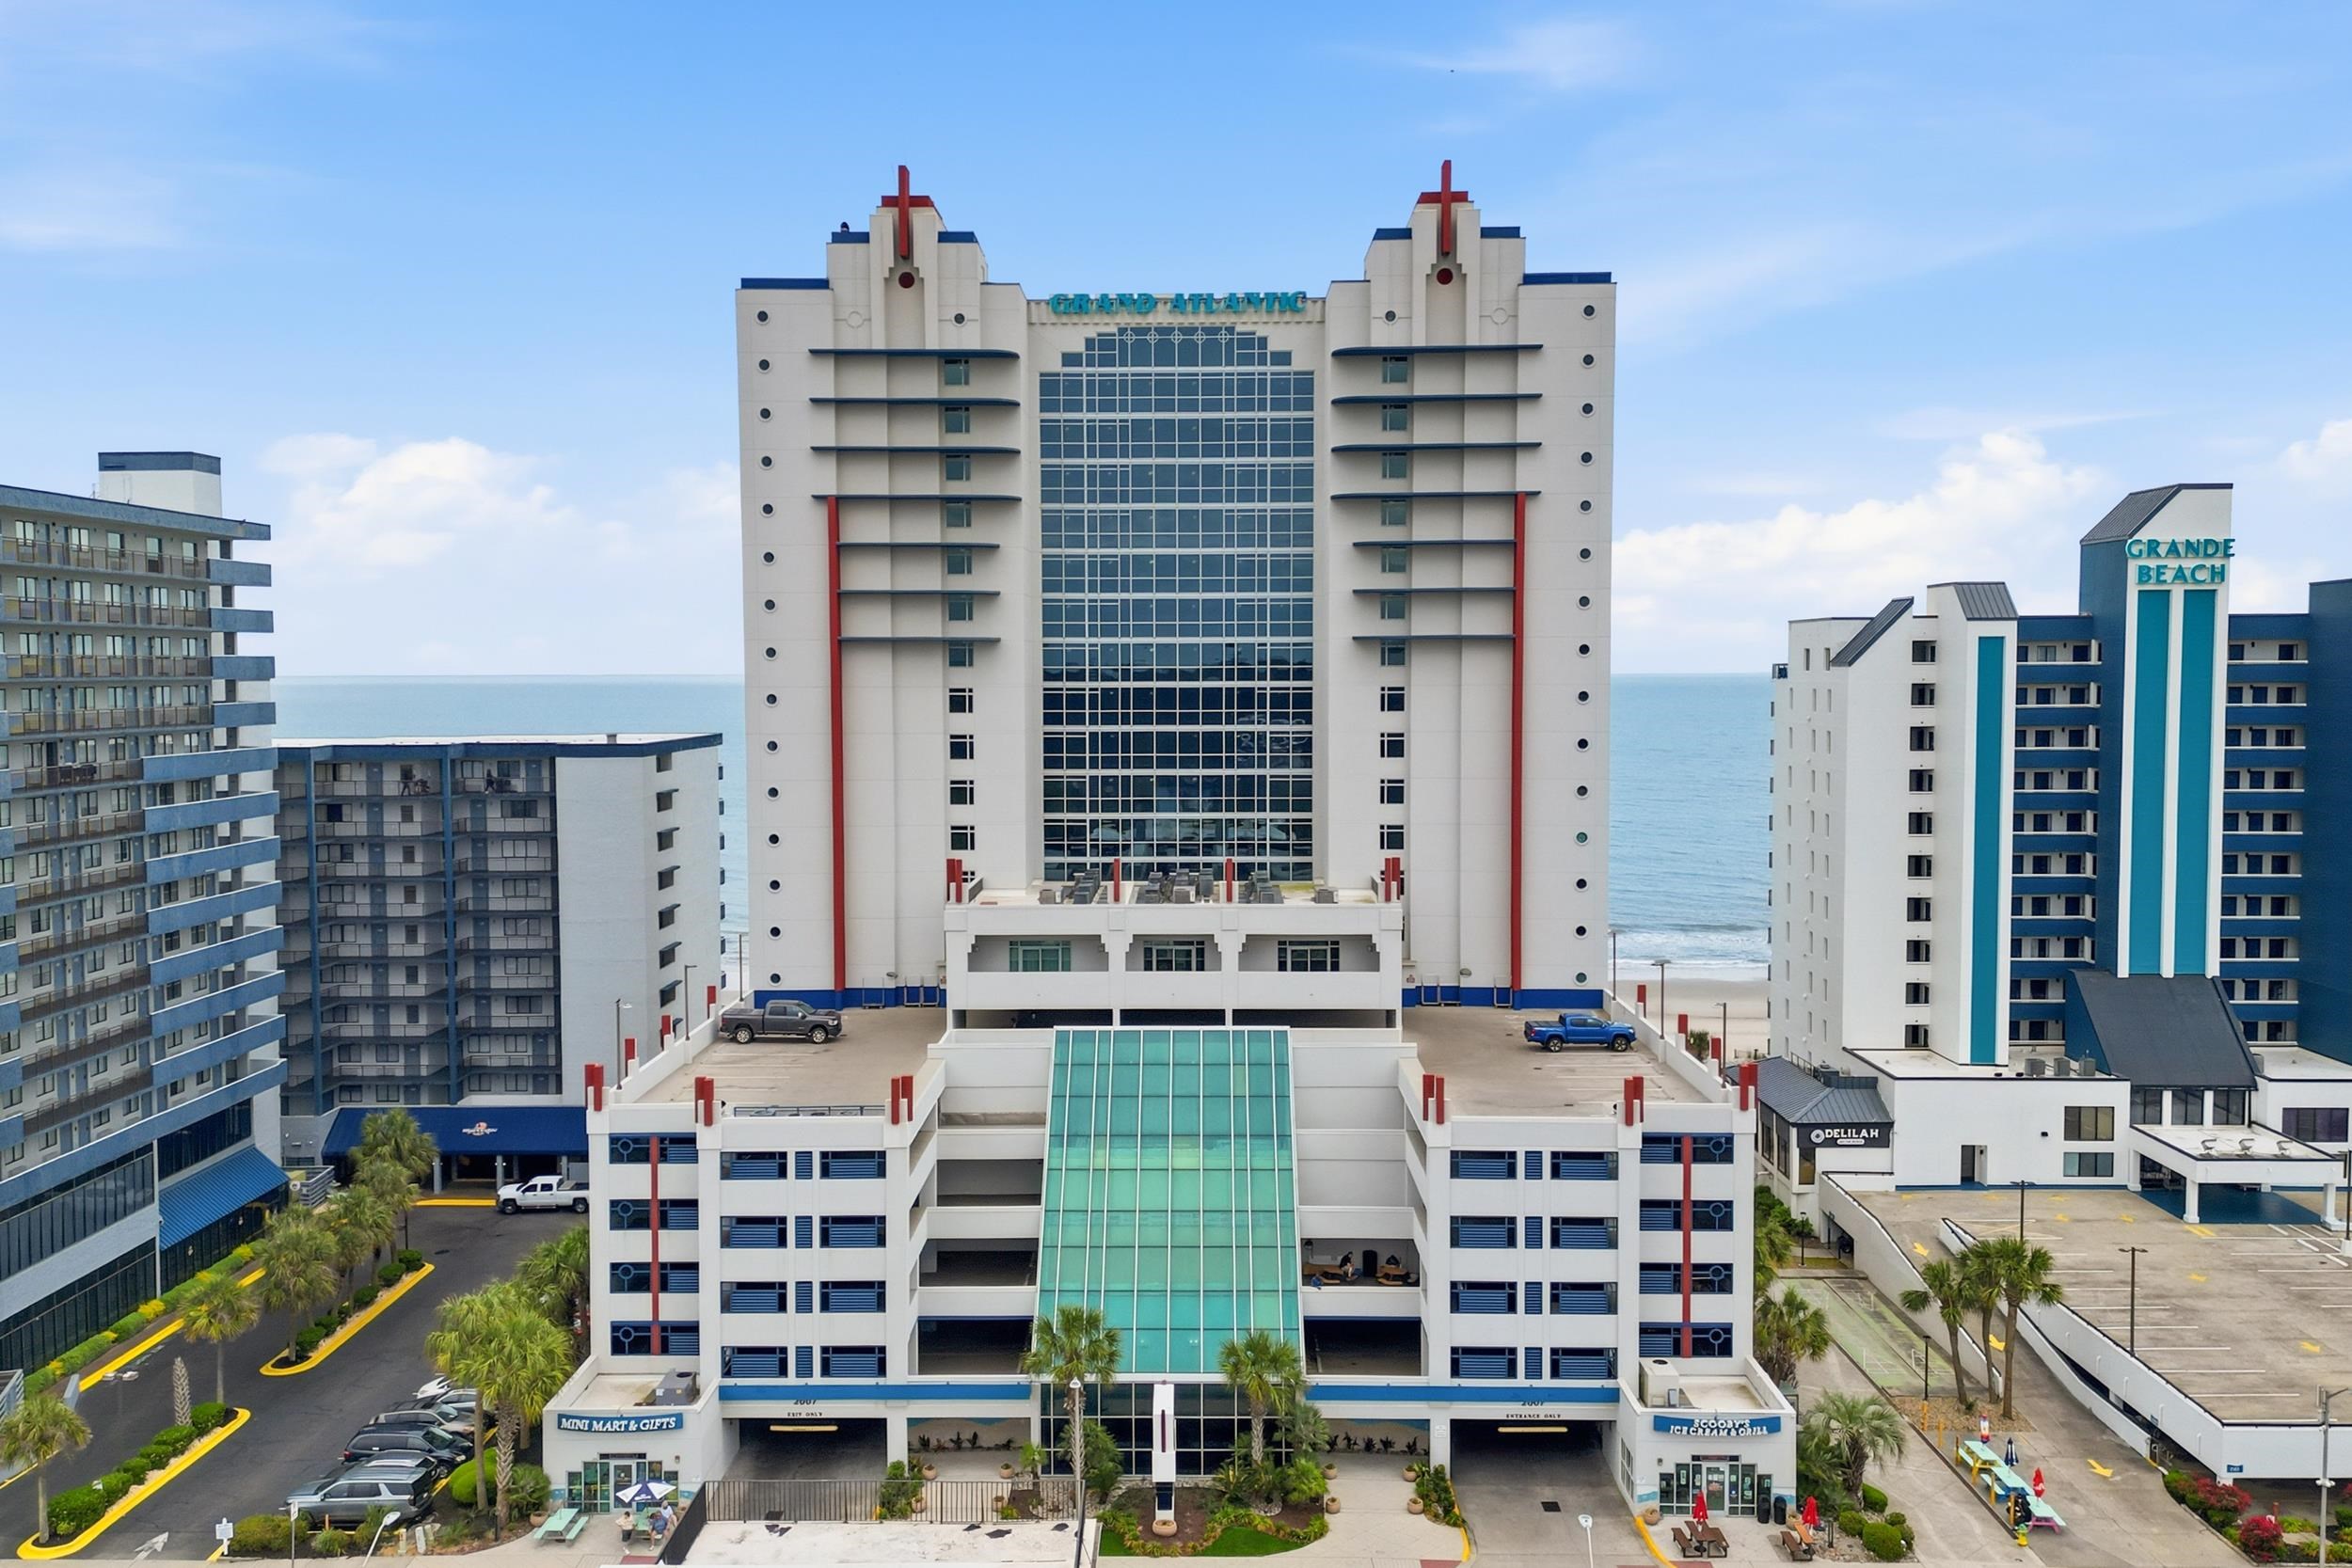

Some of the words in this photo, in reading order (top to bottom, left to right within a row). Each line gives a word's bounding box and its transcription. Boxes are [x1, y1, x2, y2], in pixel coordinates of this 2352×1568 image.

[1049, 293, 1157, 314] GRAND
[1169, 291, 1307, 313] ATLANTIC
[2125, 538, 2236, 558] GRANDE
[2137, 563, 2226, 583] BEACH
[1825, 1129, 1879, 1138] DELILAH
[561, 1418, 589, 1430] MINI
[592, 1420, 628, 1432] MART
[628, 1420, 637, 1431] &
[640, 1417, 676, 1430] GIFTS
[1670, 1425, 1688, 1434] ICE
[1689, 1427, 1727, 1436] CREAM
[1739, 1426, 1768, 1436] GRILL
[1693, 1419, 1751, 1428] SCOOBY'S
